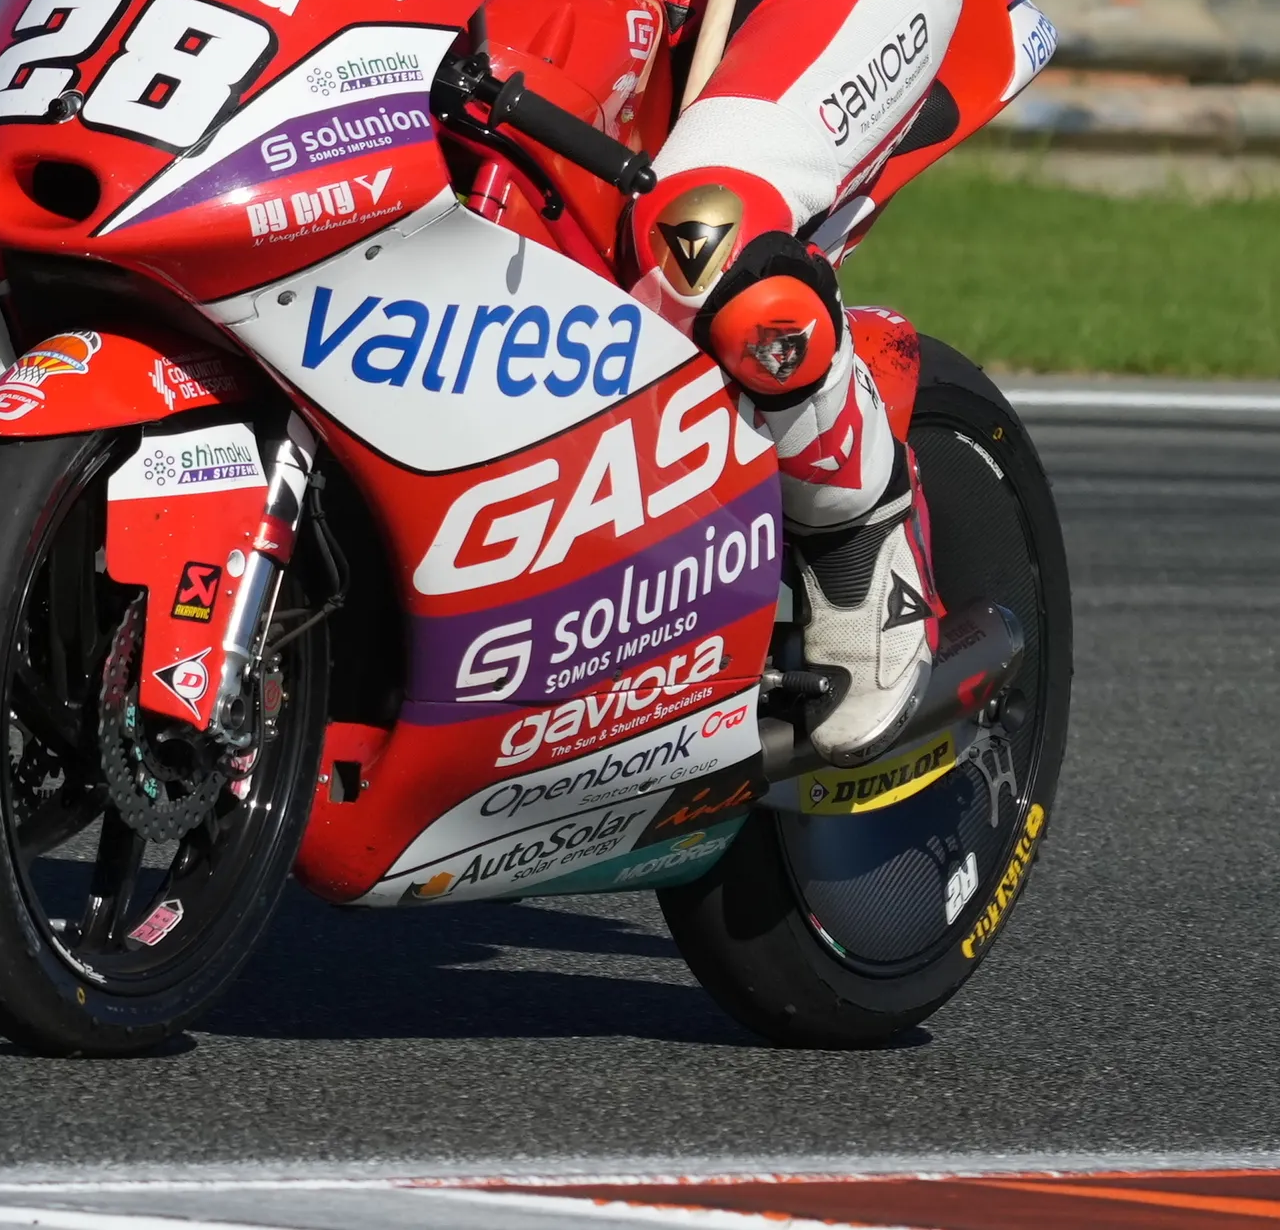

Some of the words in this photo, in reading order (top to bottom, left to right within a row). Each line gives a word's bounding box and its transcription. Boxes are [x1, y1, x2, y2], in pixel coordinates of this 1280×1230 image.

[336, 52, 420, 80] shimoku
[342, 80, 367, 92] A.I.
[370, 71, 424, 87] SYSTEMS
[820, 12, 929, 146] gaviota
[301, 107, 430, 152] solunion
[309, 145, 346, 163] SOMOS
[348, 136, 393, 153] IMPULSO
[312, 213, 359, 233] technical
[360, 200, 403, 224] garment
[178, 381, 197, 399] DE
[181, 443, 253, 468] shimoku
[181, 470, 207, 483] A.I.
[412, 364, 776, 596] GAS
[550, 512, 776, 664] solunion
[544, 651, 611, 695] SOMOS
[616, 612, 698, 664] IMPULSO
[494, 635, 724, 767] gaviota
[551, 744, 572, 758] The
[574, 735, 596, 750] Sun
[598, 729, 608, 741] &
[609, 713, 652, 738] Shutter
[653, 686, 713, 720] Specialists
[480, 725, 698, 817] Openbank
[670, 758, 718, 780] Group
[832, 741, 949, 803] DUNLOP
[449, 809, 646, 892] AutoSolar
[511, 857, 558, 882] solar
[560, 834, 625, 866] energy
[613, 833, 735, 884] MOTOREX
